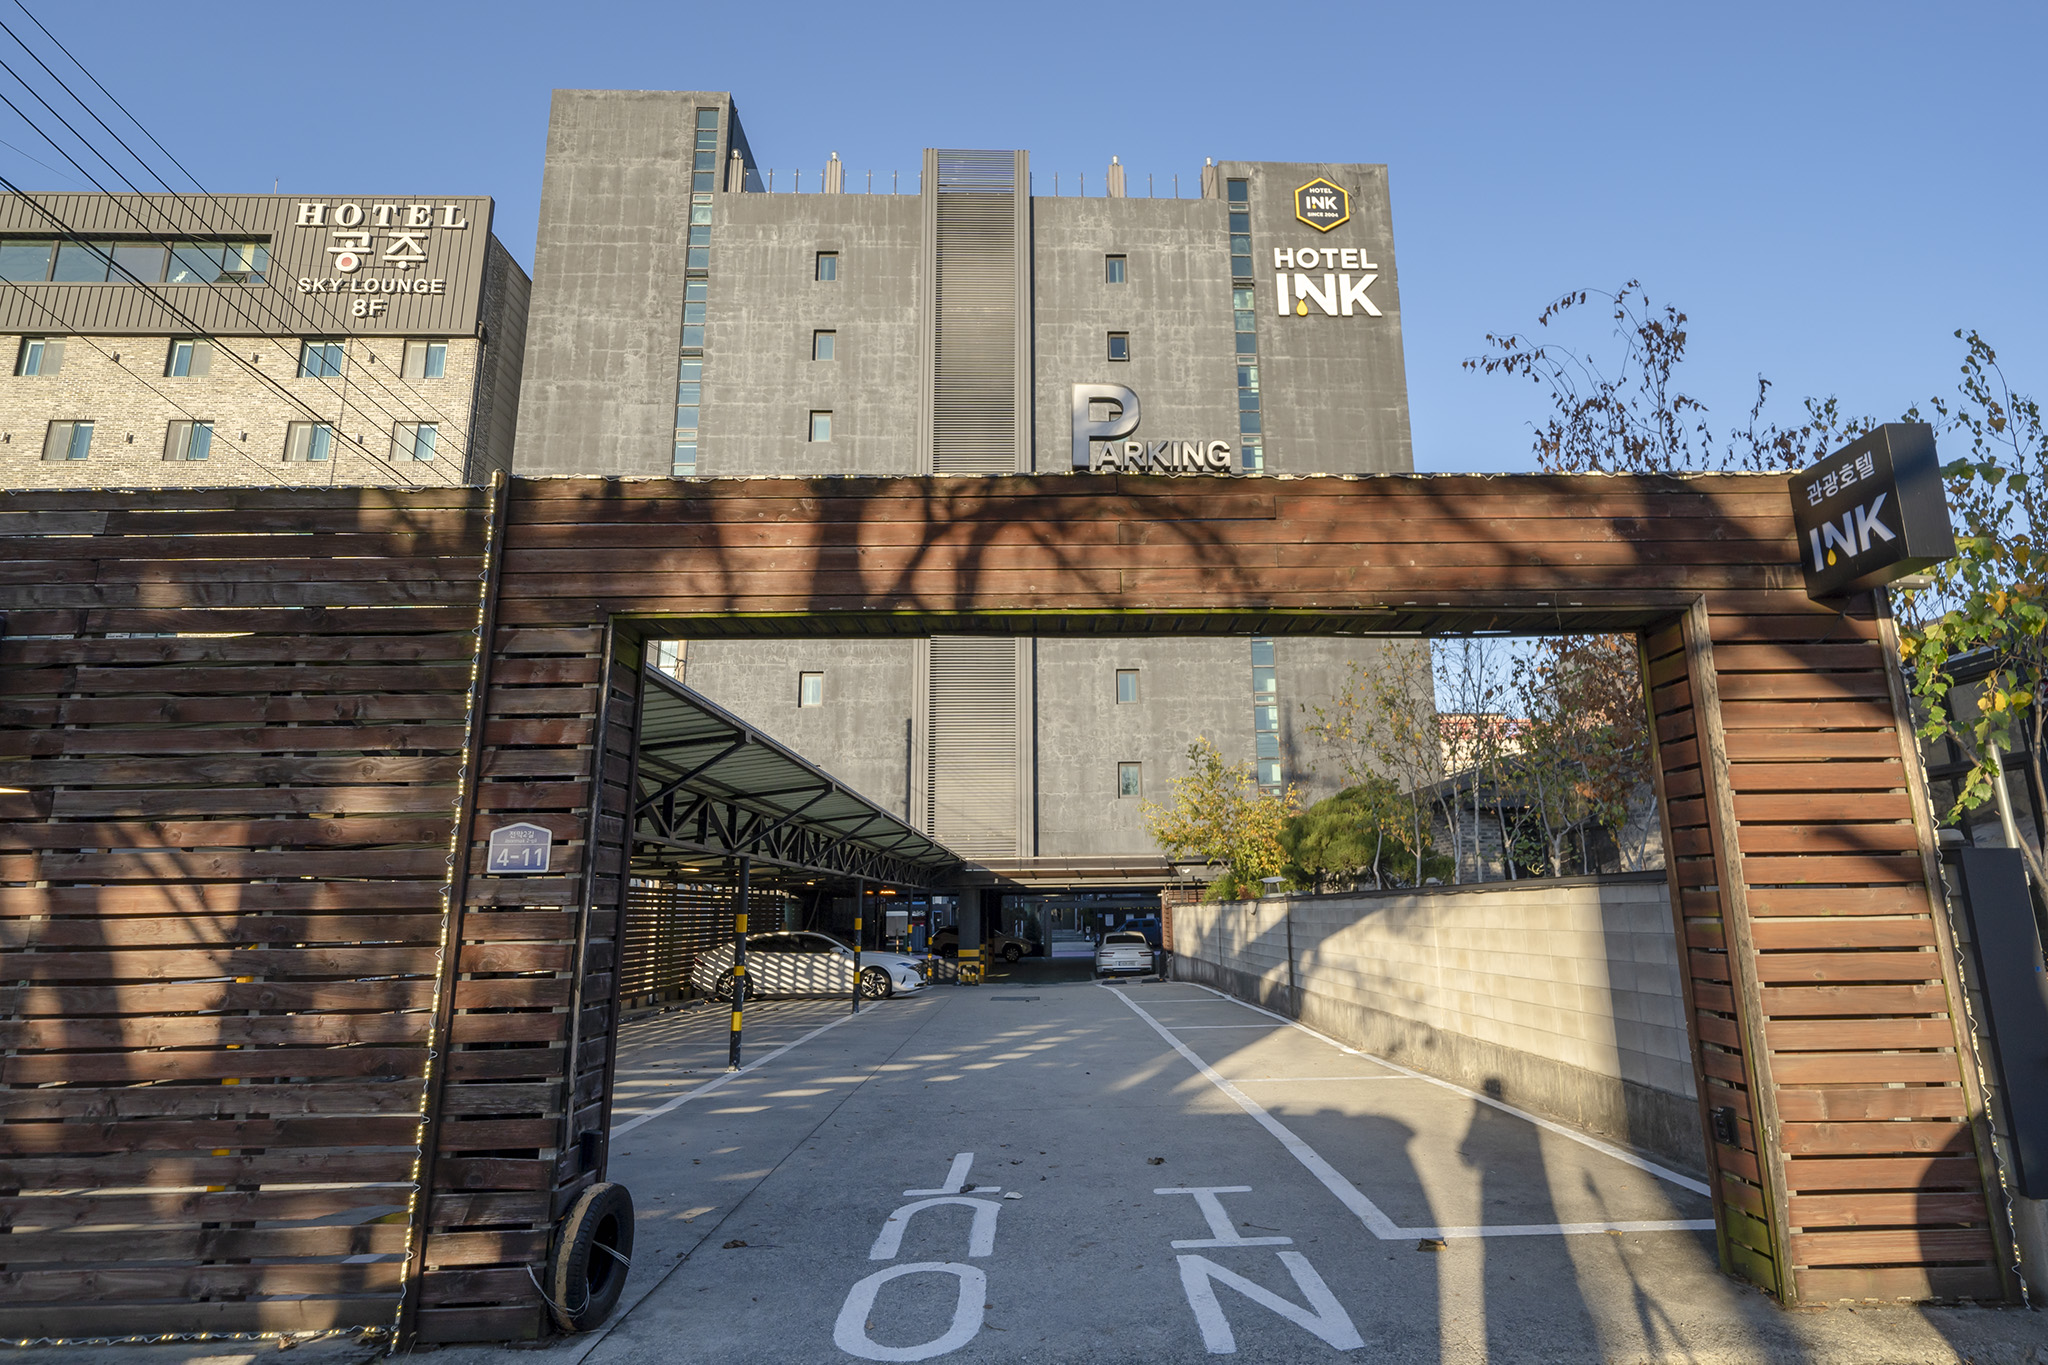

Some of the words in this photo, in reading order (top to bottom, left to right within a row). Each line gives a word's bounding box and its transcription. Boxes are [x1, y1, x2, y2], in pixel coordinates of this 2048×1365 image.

[295, 203, 467, 229] HOTEL
[1305, 196, 1338, 210] INK
[327, 231, 427, 273] 공주
[1274, 247, 1378, 269] HOTEL
[297, 277, 344, 294] SKY
[351, 278, 446, 295] LOUNGE
[1276, 273, 1383, 317] INK
[351, 299, 386, 318] 8F
[1072, 383, 1232, 473] PARKING
[1806, 450, 1875, 507] 관광호텔
[1809, 492, 1896, 573] INK
[496, 848, 542, 867] 4-11
